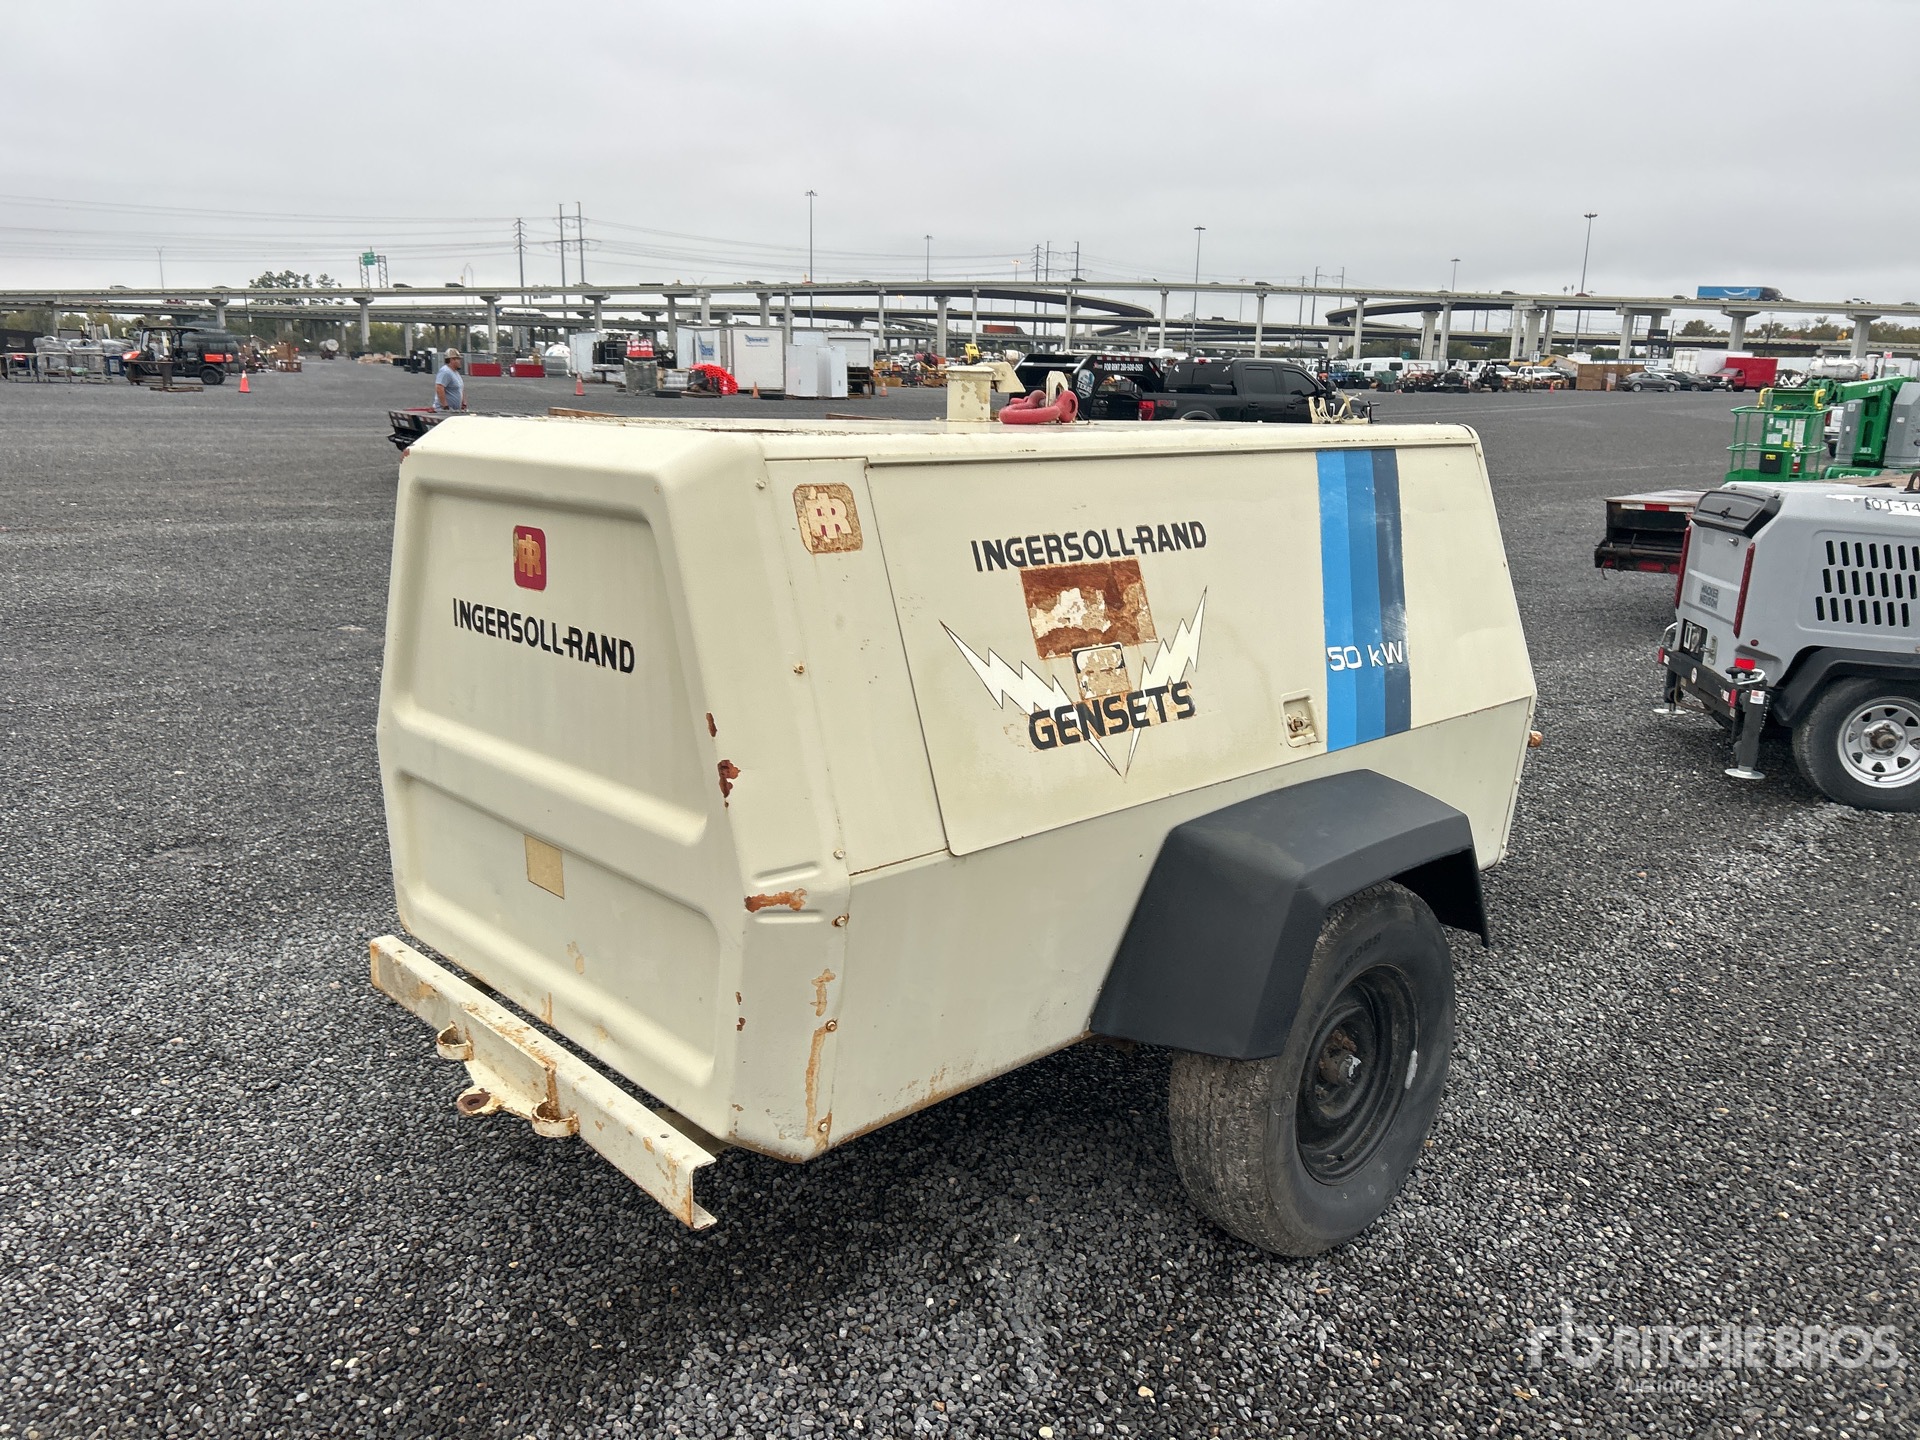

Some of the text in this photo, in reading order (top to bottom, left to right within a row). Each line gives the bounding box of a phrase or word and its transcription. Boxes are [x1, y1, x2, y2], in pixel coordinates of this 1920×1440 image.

[971, 520, 1207, 572] INGERSOLL-RAND
[453, 598, 635, 674] INGERSOLL-RAND
[1327, 641, 1403, 671] 50 kW
[1029, 680, 1197, 751] GENSETS
